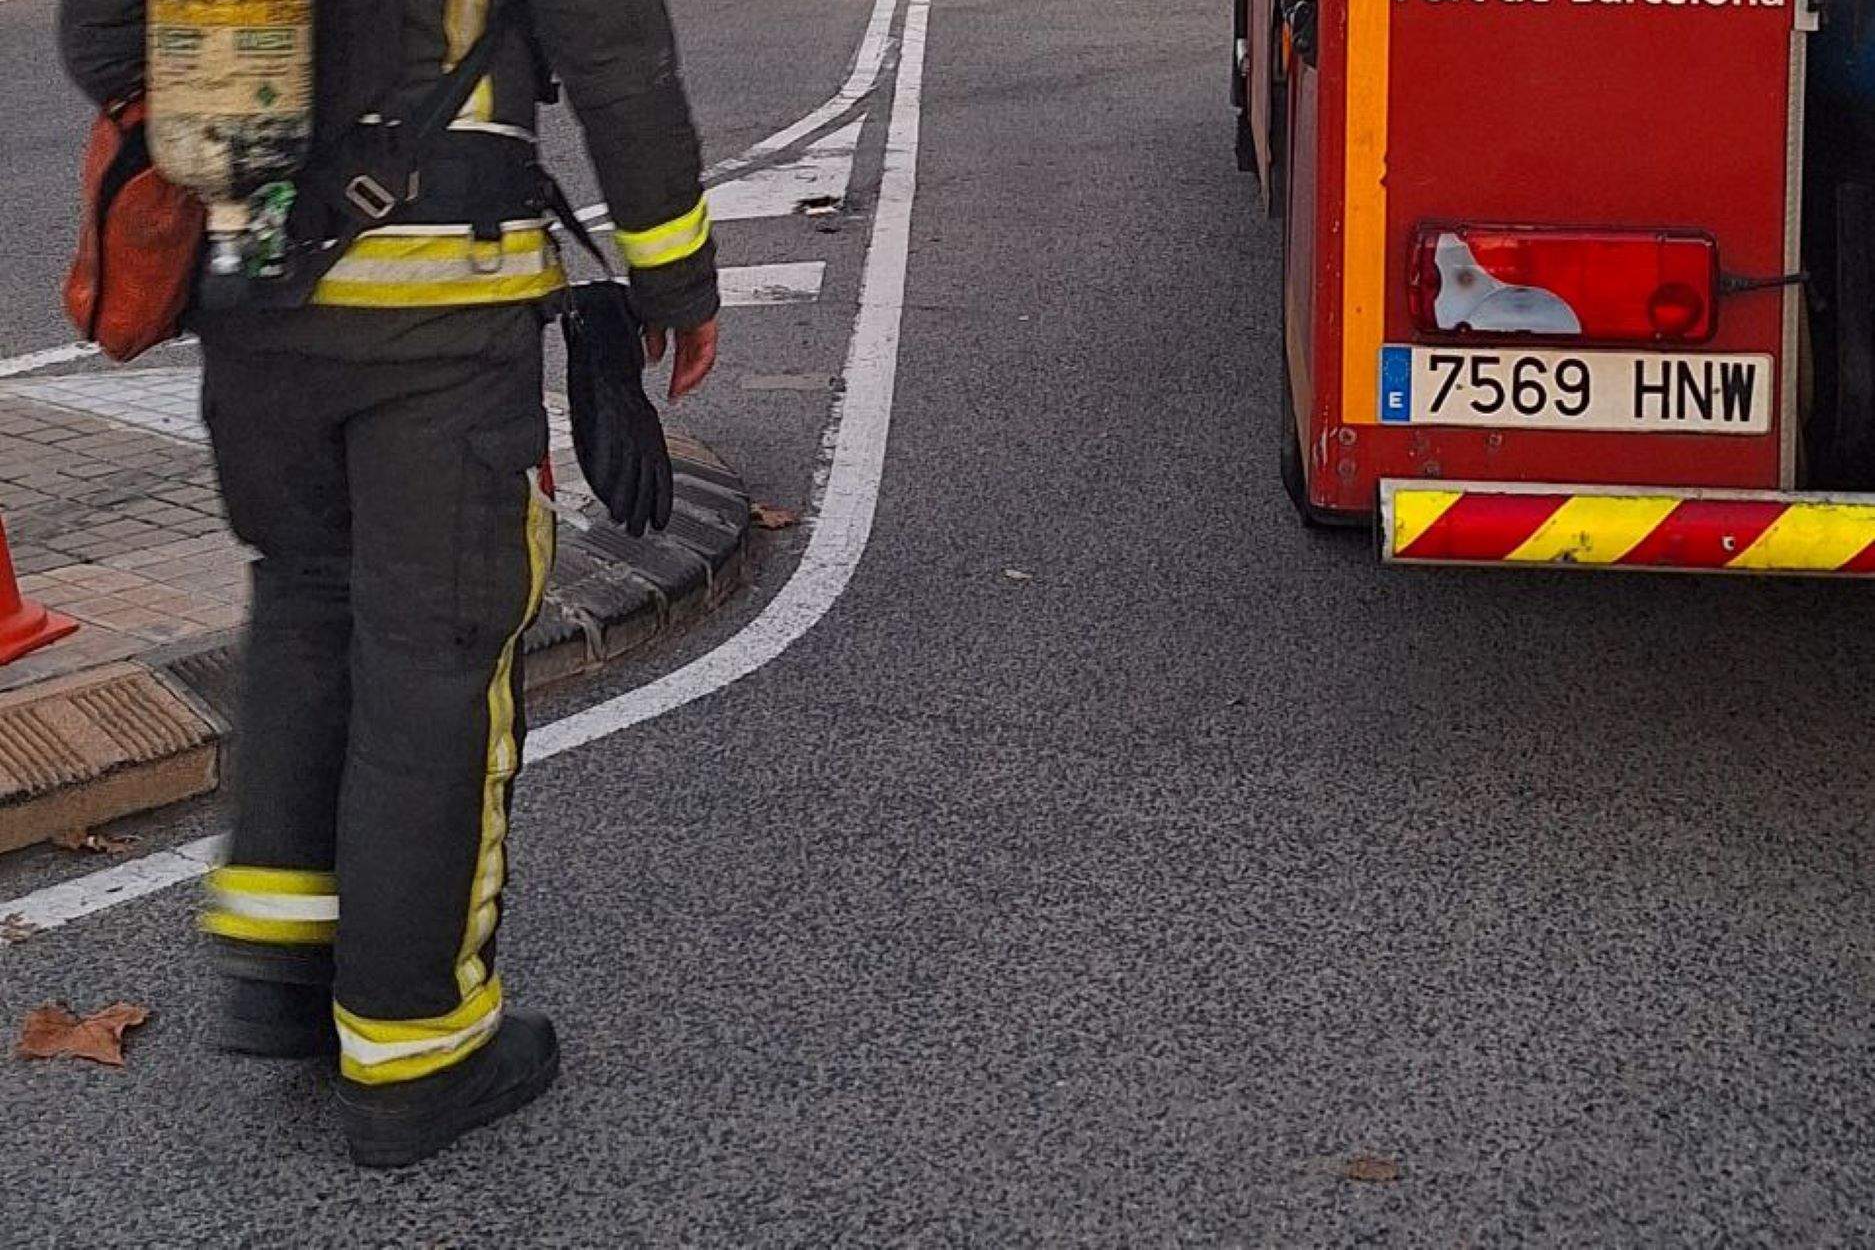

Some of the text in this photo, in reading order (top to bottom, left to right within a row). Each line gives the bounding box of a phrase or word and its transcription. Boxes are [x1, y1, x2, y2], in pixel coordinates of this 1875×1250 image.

[1389, 392, 1404, 408] E
[1429, 355, 1756, 421] 7569 HNW
